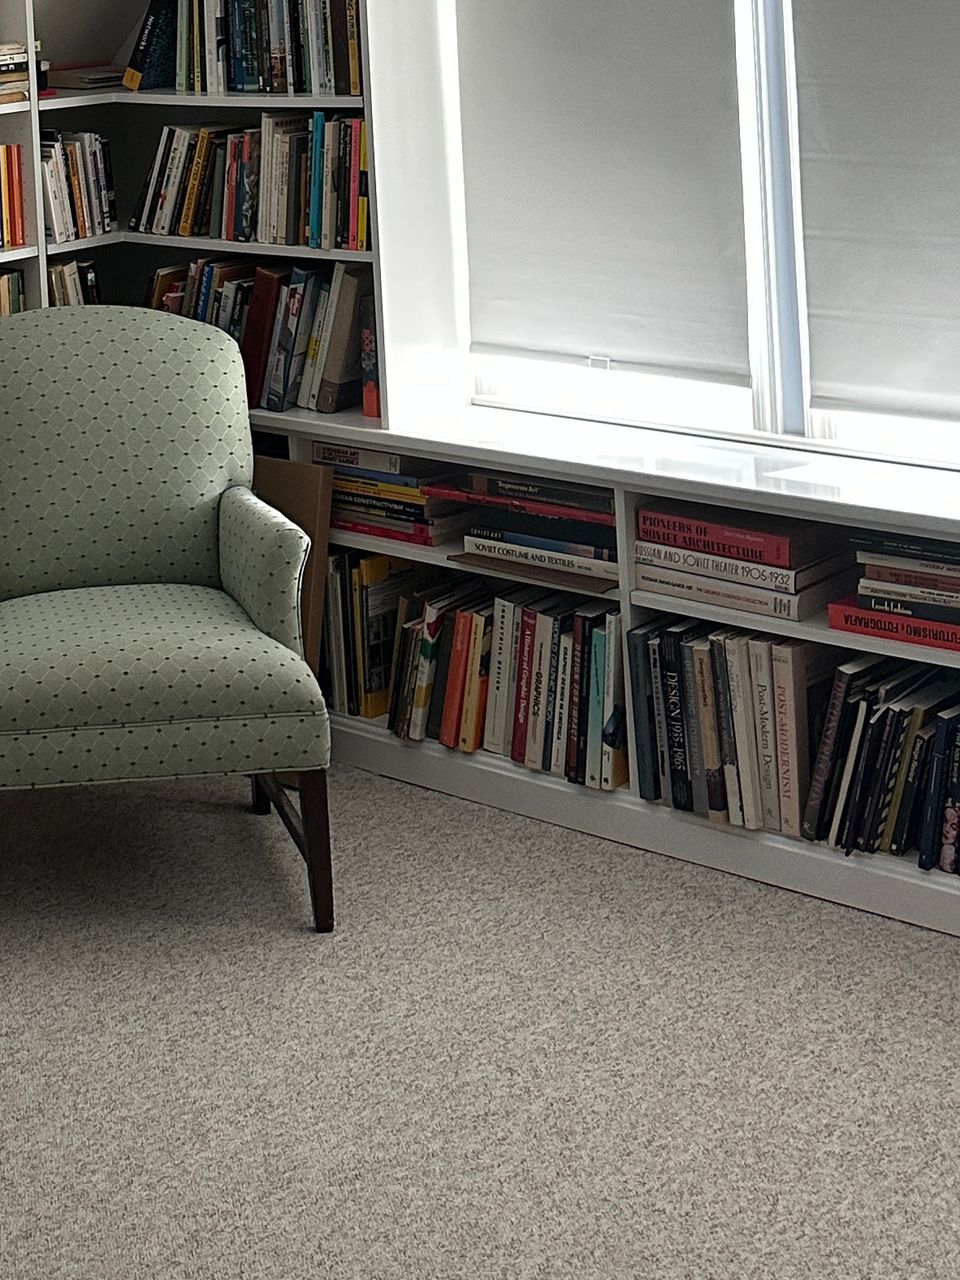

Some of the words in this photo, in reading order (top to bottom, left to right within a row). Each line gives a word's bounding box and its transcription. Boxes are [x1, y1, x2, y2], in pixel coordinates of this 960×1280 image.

[139, 15, 155, 50] Networks
[642, 515, 692, 534] PIONEERS
[695, 525, 710, 537] OF
[474, 543, 496, 554] SOVIET
[497, 547, 529, 560] COSTUME
[530, 552, 546, 562] AND
[547, 556, 575, 567] TEXTILES
[642, 526, 679, 544] SOVIET
[681, 534, 765, 561] ARCHITECTURE
[634, 541, 662, 560] RUSSIAN
[663, 550, 681, 565] AND
[682, 553, 710, 568] SOVIET
[710, 557, 739, 575] THEATER
[740, 565, 791, 586] 1905-1932
[843, 613, 899, 633] FOTOGRAFIA
[890, 602, 913, 615] Cubism
[497, 605, 506, 656] INDUSTRIAL
[551, 621, 560, 652] WORLD
[520, 635, 531, 662] History
[561, 646, 569, 677] GRAPHIC
[573, 643, 581, 680] DESIGN
[522, 662, 529, 670] of
[519, 669, 529, 699] Graphic
[531, 671, 543, 717] GRAPHICS
[572, 682, 580, 704] FOR
[666, 671, 679, 718] DESIGN
[684, 660, 695, 716] DESIGNING
[517, 700, 527, 724] Design
[546, 691, 555, 723] DESIGN
[559, 703, 565, 711] IN
[570, 705, 578, 742] IMPACT
[757, 683, 770, 749] Post-Modern
[672, 720, 686, 771] 1935-1965
[689, 718, 700, 777] MODERNITY
[777, 685, 791, 800] POST-MODERNISM
[809, 682, 844, 808] DECONSTRUCTION
[911, 739, 924, 760] Design
[763, 753, 773, 790] Design
[907, 759, 917, 783] Review
